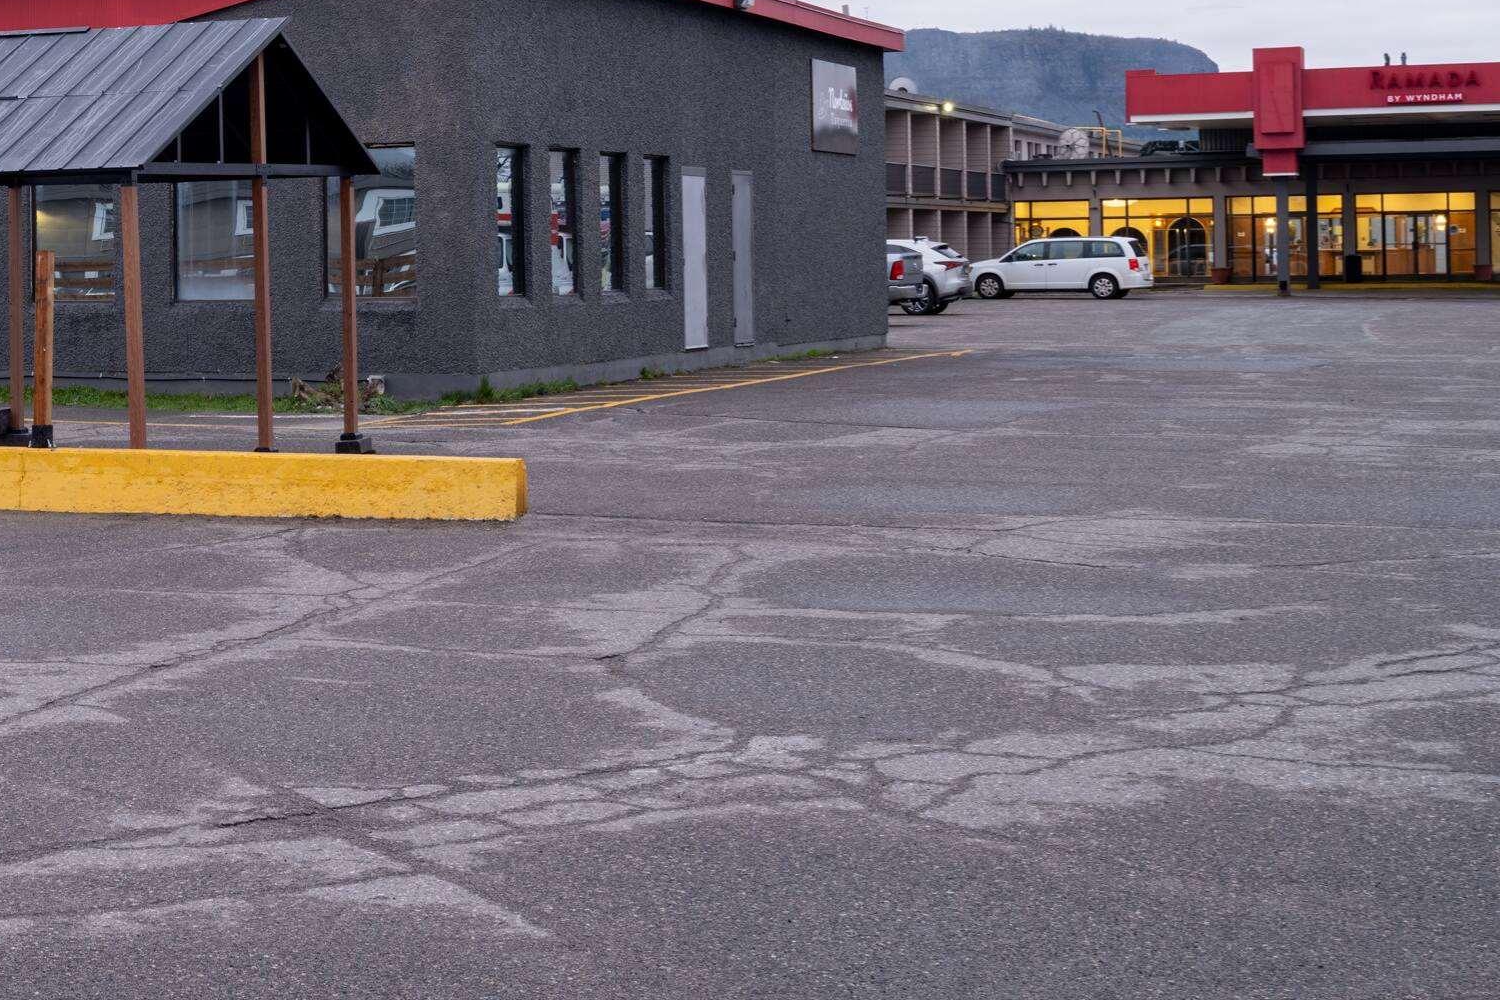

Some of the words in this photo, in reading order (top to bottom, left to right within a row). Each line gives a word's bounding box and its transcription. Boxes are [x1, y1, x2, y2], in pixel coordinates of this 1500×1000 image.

[1369, 69, 1482, 90] RAMADA
[1386, 95, 1401, 103] BY
[1405, 93, 1463, 102] WYNDHAM
